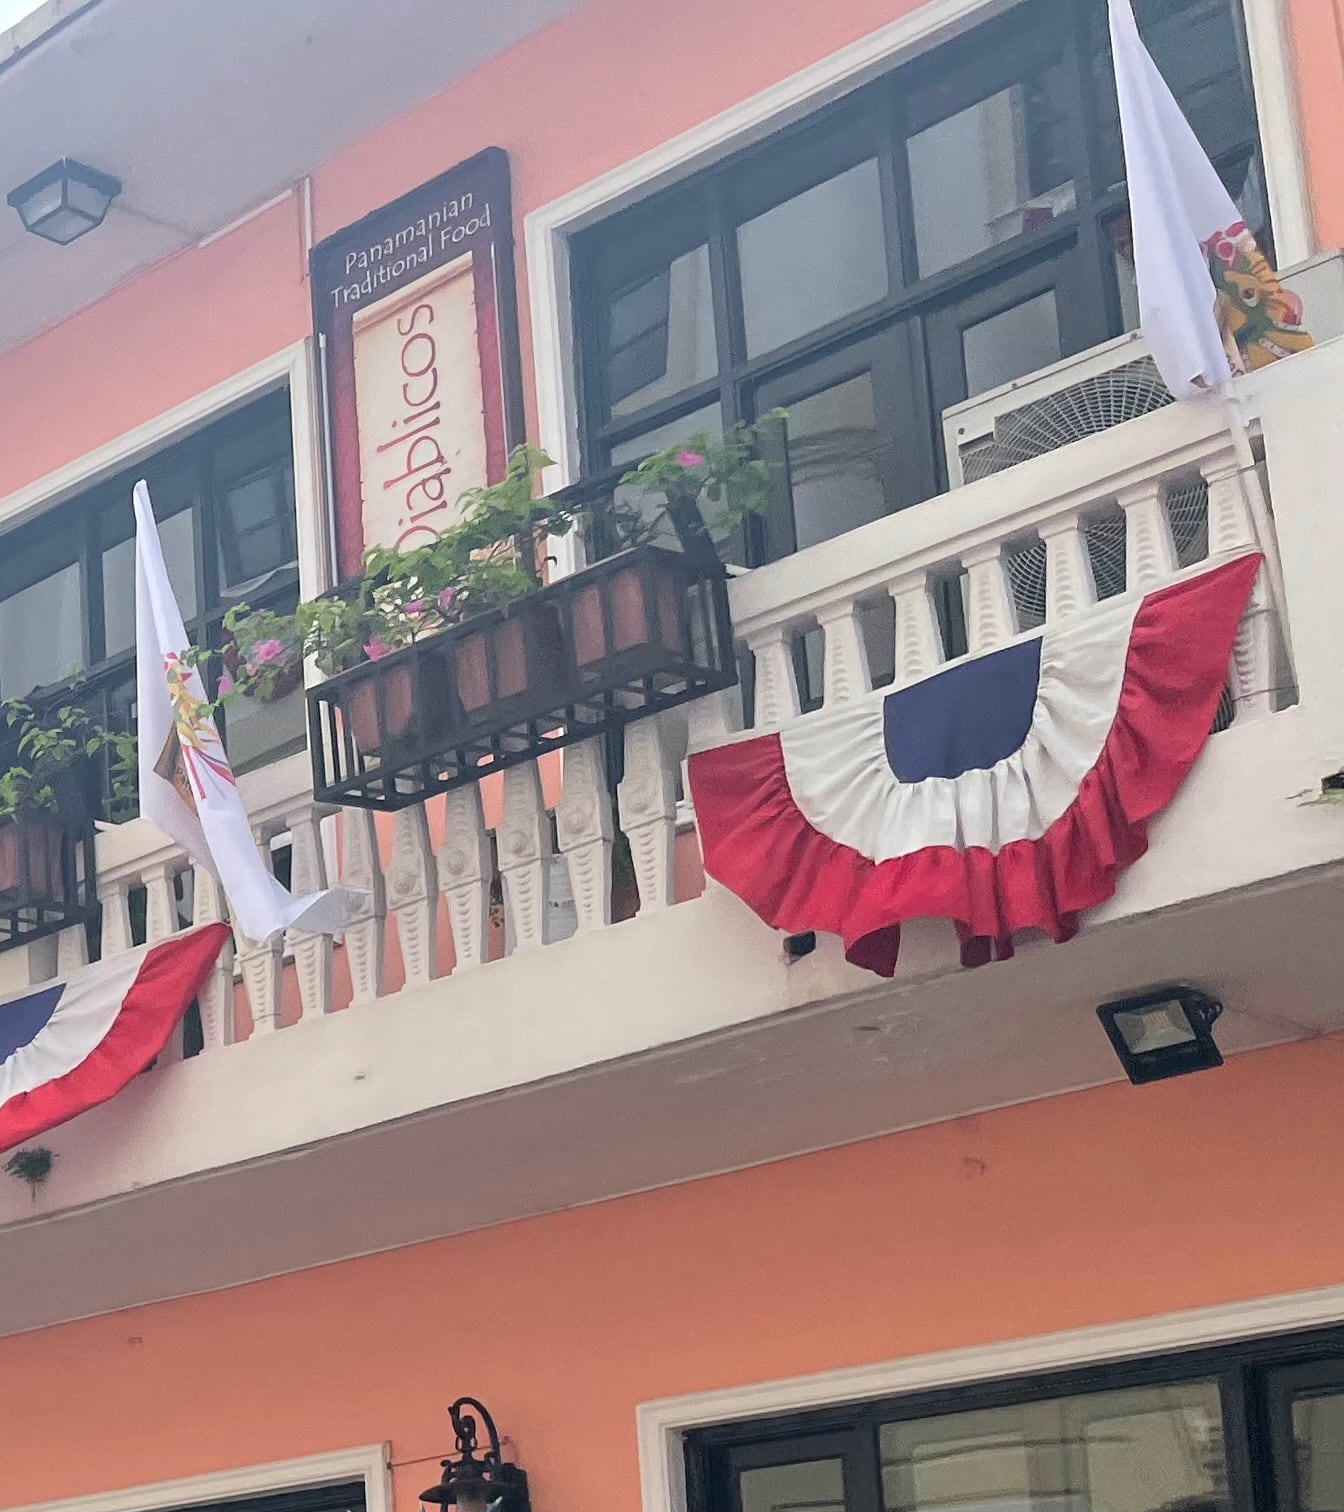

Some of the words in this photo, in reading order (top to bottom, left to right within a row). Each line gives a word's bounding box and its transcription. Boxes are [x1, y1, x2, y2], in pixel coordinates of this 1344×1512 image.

[331, 241, 433, 309] Traditional
[440, 203, 491, 251] Food
[344, 192, 473, 275] Panamanian
